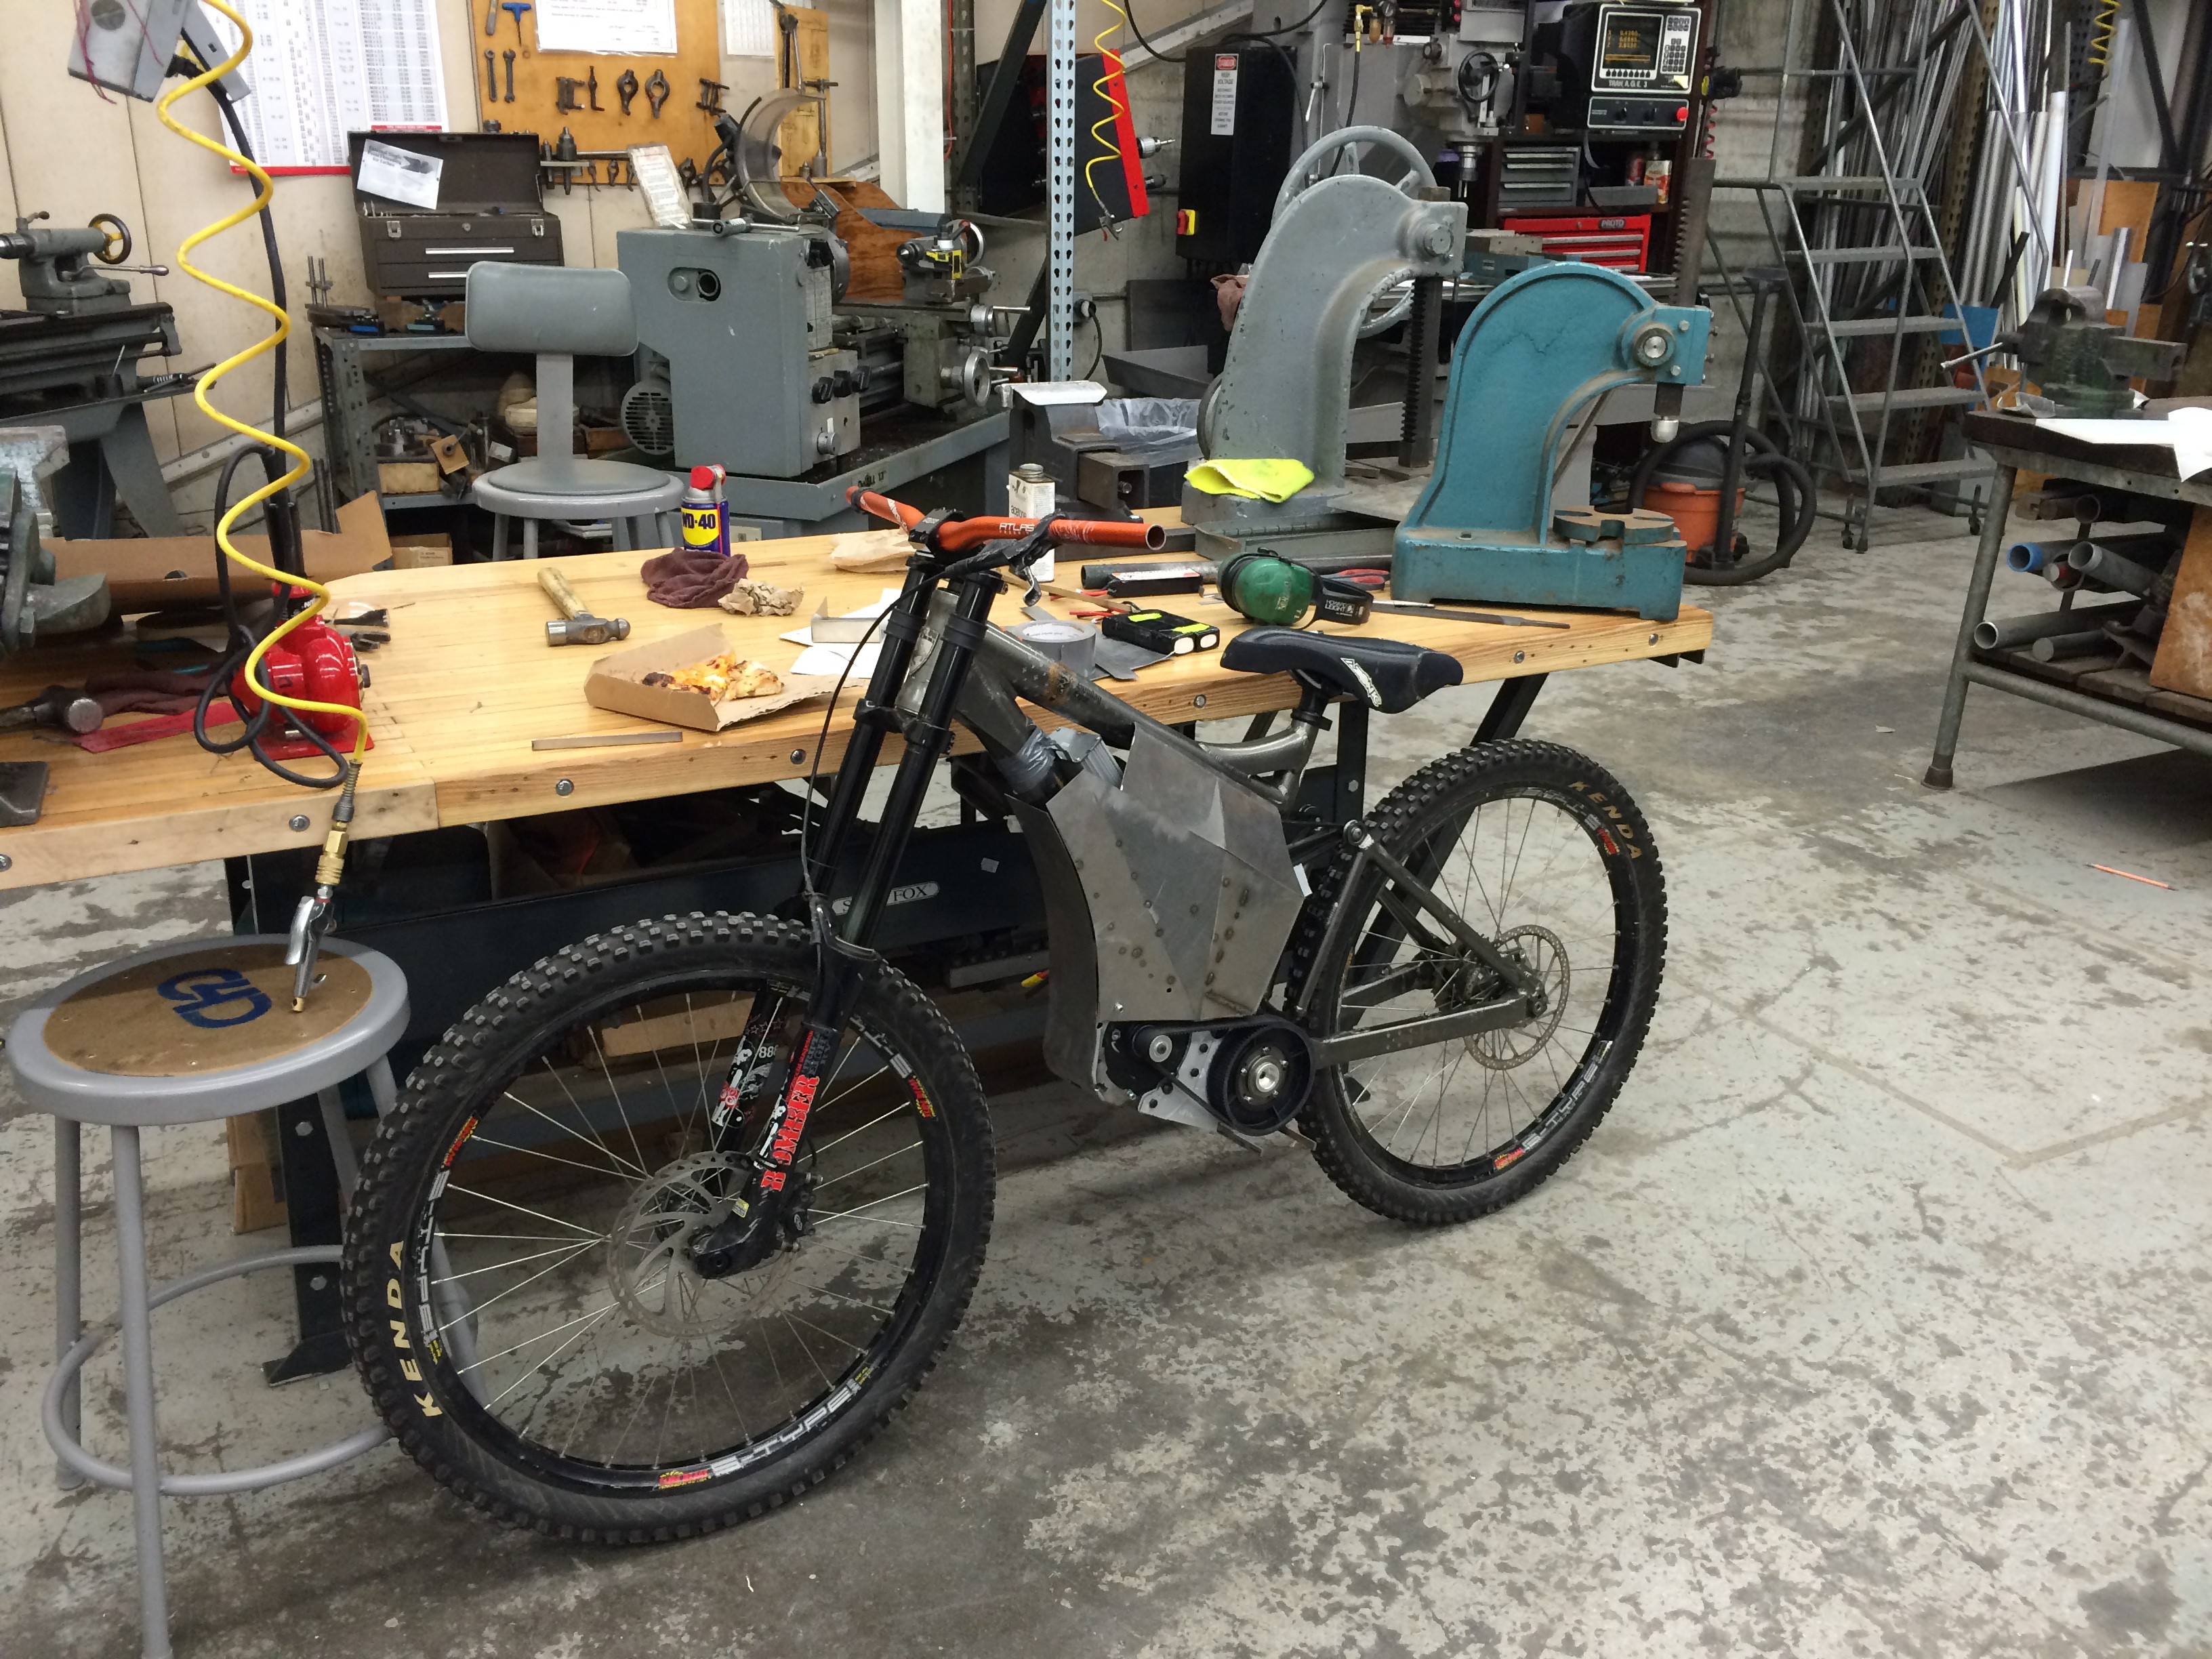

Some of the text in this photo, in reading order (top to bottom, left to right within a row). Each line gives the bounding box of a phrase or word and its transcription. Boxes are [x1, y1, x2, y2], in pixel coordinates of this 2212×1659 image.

[1601, 219, 1625, 228] PROTO
[682, 512, 716, 529] WD-40
[999, 523, 1035, 532] ATLAS
[1568, 781, 1643, 859] KENDA
[893, 885, 927, 901] FOX
[758, 1044, 778, 1059] 88
[386, 1240, 443, 1417] KENDA
